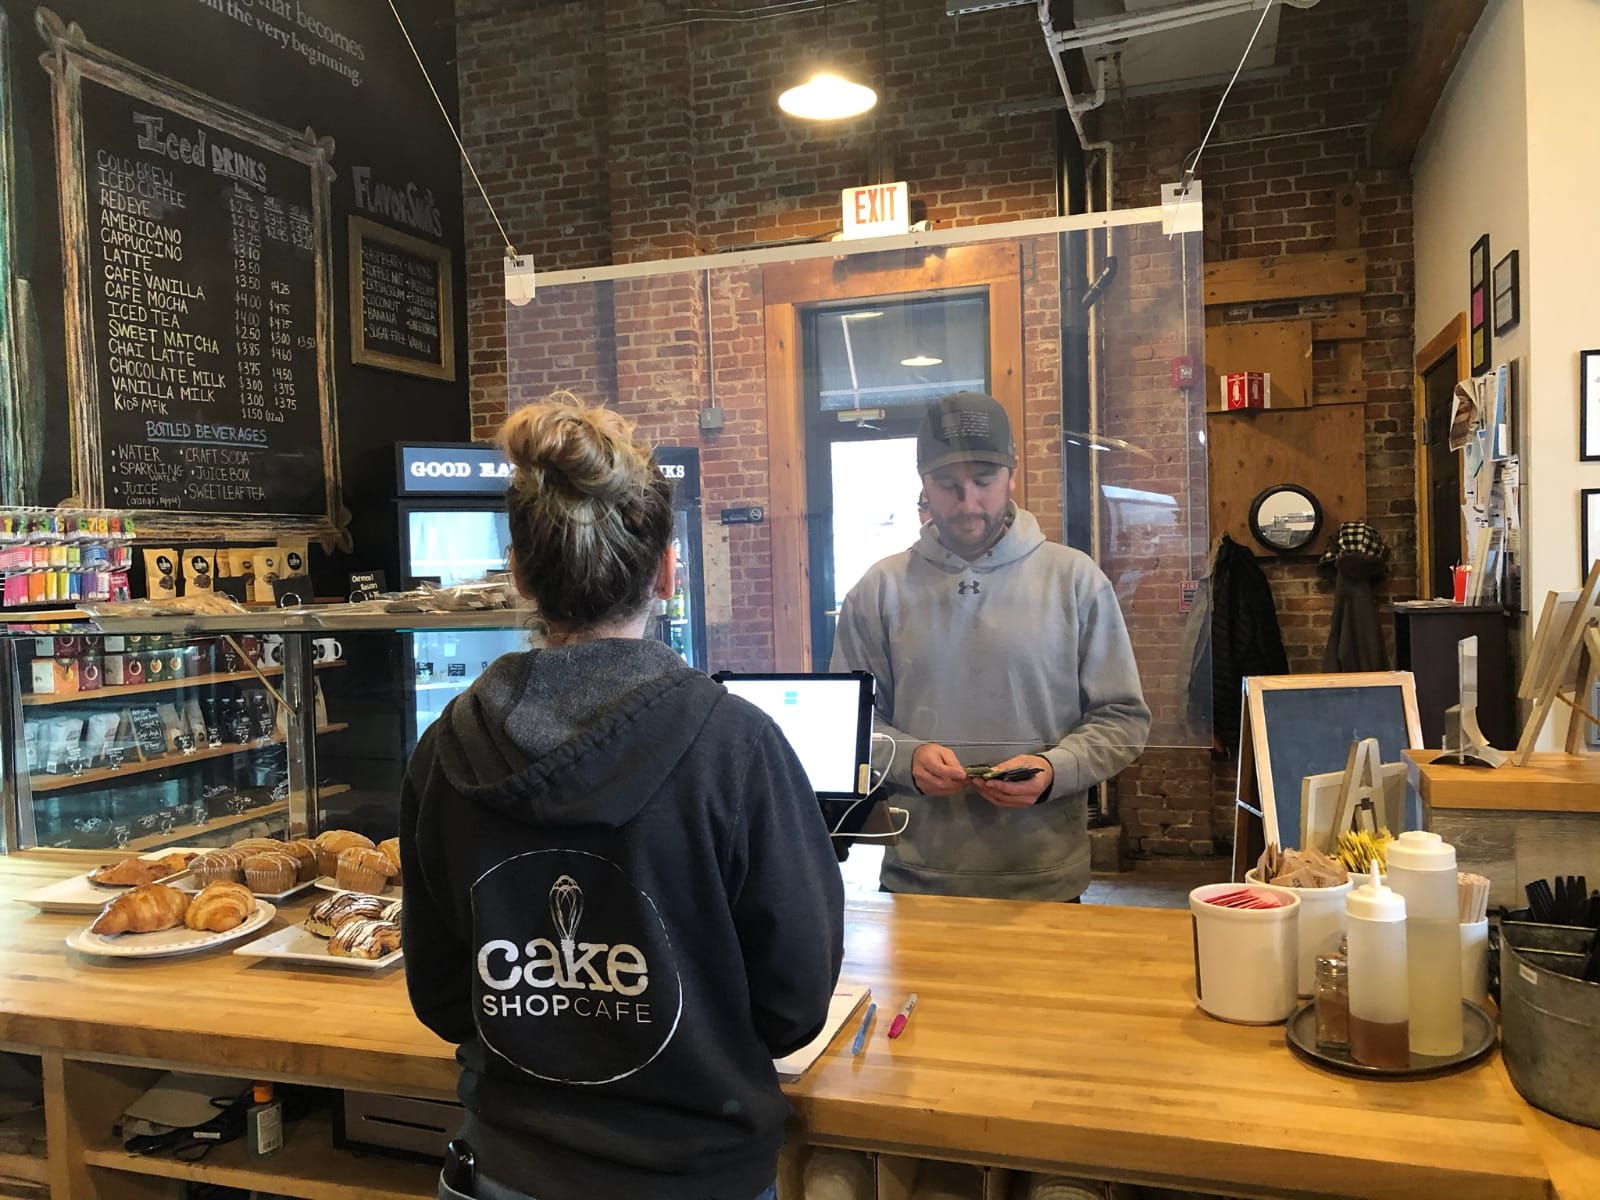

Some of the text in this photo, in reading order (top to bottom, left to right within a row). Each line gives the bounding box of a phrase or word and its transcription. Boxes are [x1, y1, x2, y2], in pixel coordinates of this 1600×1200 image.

[227, 1, 253, 26] the
[255, 18, 290, 49] very
[296, 2, 366, 61] becomes
[132, 111, 267, 183] Iced DRINKS
[97, 149, 135, 177] COLD
[136, 161, 173, 188] BREW
[97, 166, 135, 193] ICED
[137, 180, 187, 209] COFFEE
[855, 186, 897, 224] EXIT
[100, 208, 182, 245] AMERICANO
[100, 227, 182, 262] CAPPUCCINO
[103, 245, 152, 272] LATTE
[104, 264, 143, 287] CAFE
[144, 272, 206, 300] VANILLA
[105, 281, 143, 304] CAFE
[147, 290, 188, 315] MOCHA
[107, 300, 148, 322] ICED
[150, 308, 181, 329] TEA
[367, 307, 398, 325] BANANA
[108, 318, 158, 344] SWEET
[163, 330, 220, 355] MATCHA
[108, 337, 145, 359] CHAI
[151, 344, 197, 367] LATTE
[109, 356, 188, 384] CHOCOLATE
[192, 370, 226, 389] MILK
[111, 375, 175, 399] VANILLA
[180, 386, 216, 402] MILK
[146, 420, 268, 443] BOTTLED BEVERAGES
[119, 444, 162, 463] WATER
[119, 461, 184, 477] SPARKLING
[185, 448, 250, 465] CRAFT SODA
[410, 461, 472, 477] GOOD
[122, 482, 159, 495] JUICE
[150, 473, 177, 483] WATER
[196, 466, 251, 482] JUICE BOX
[477, 937, 649, 997] cake
